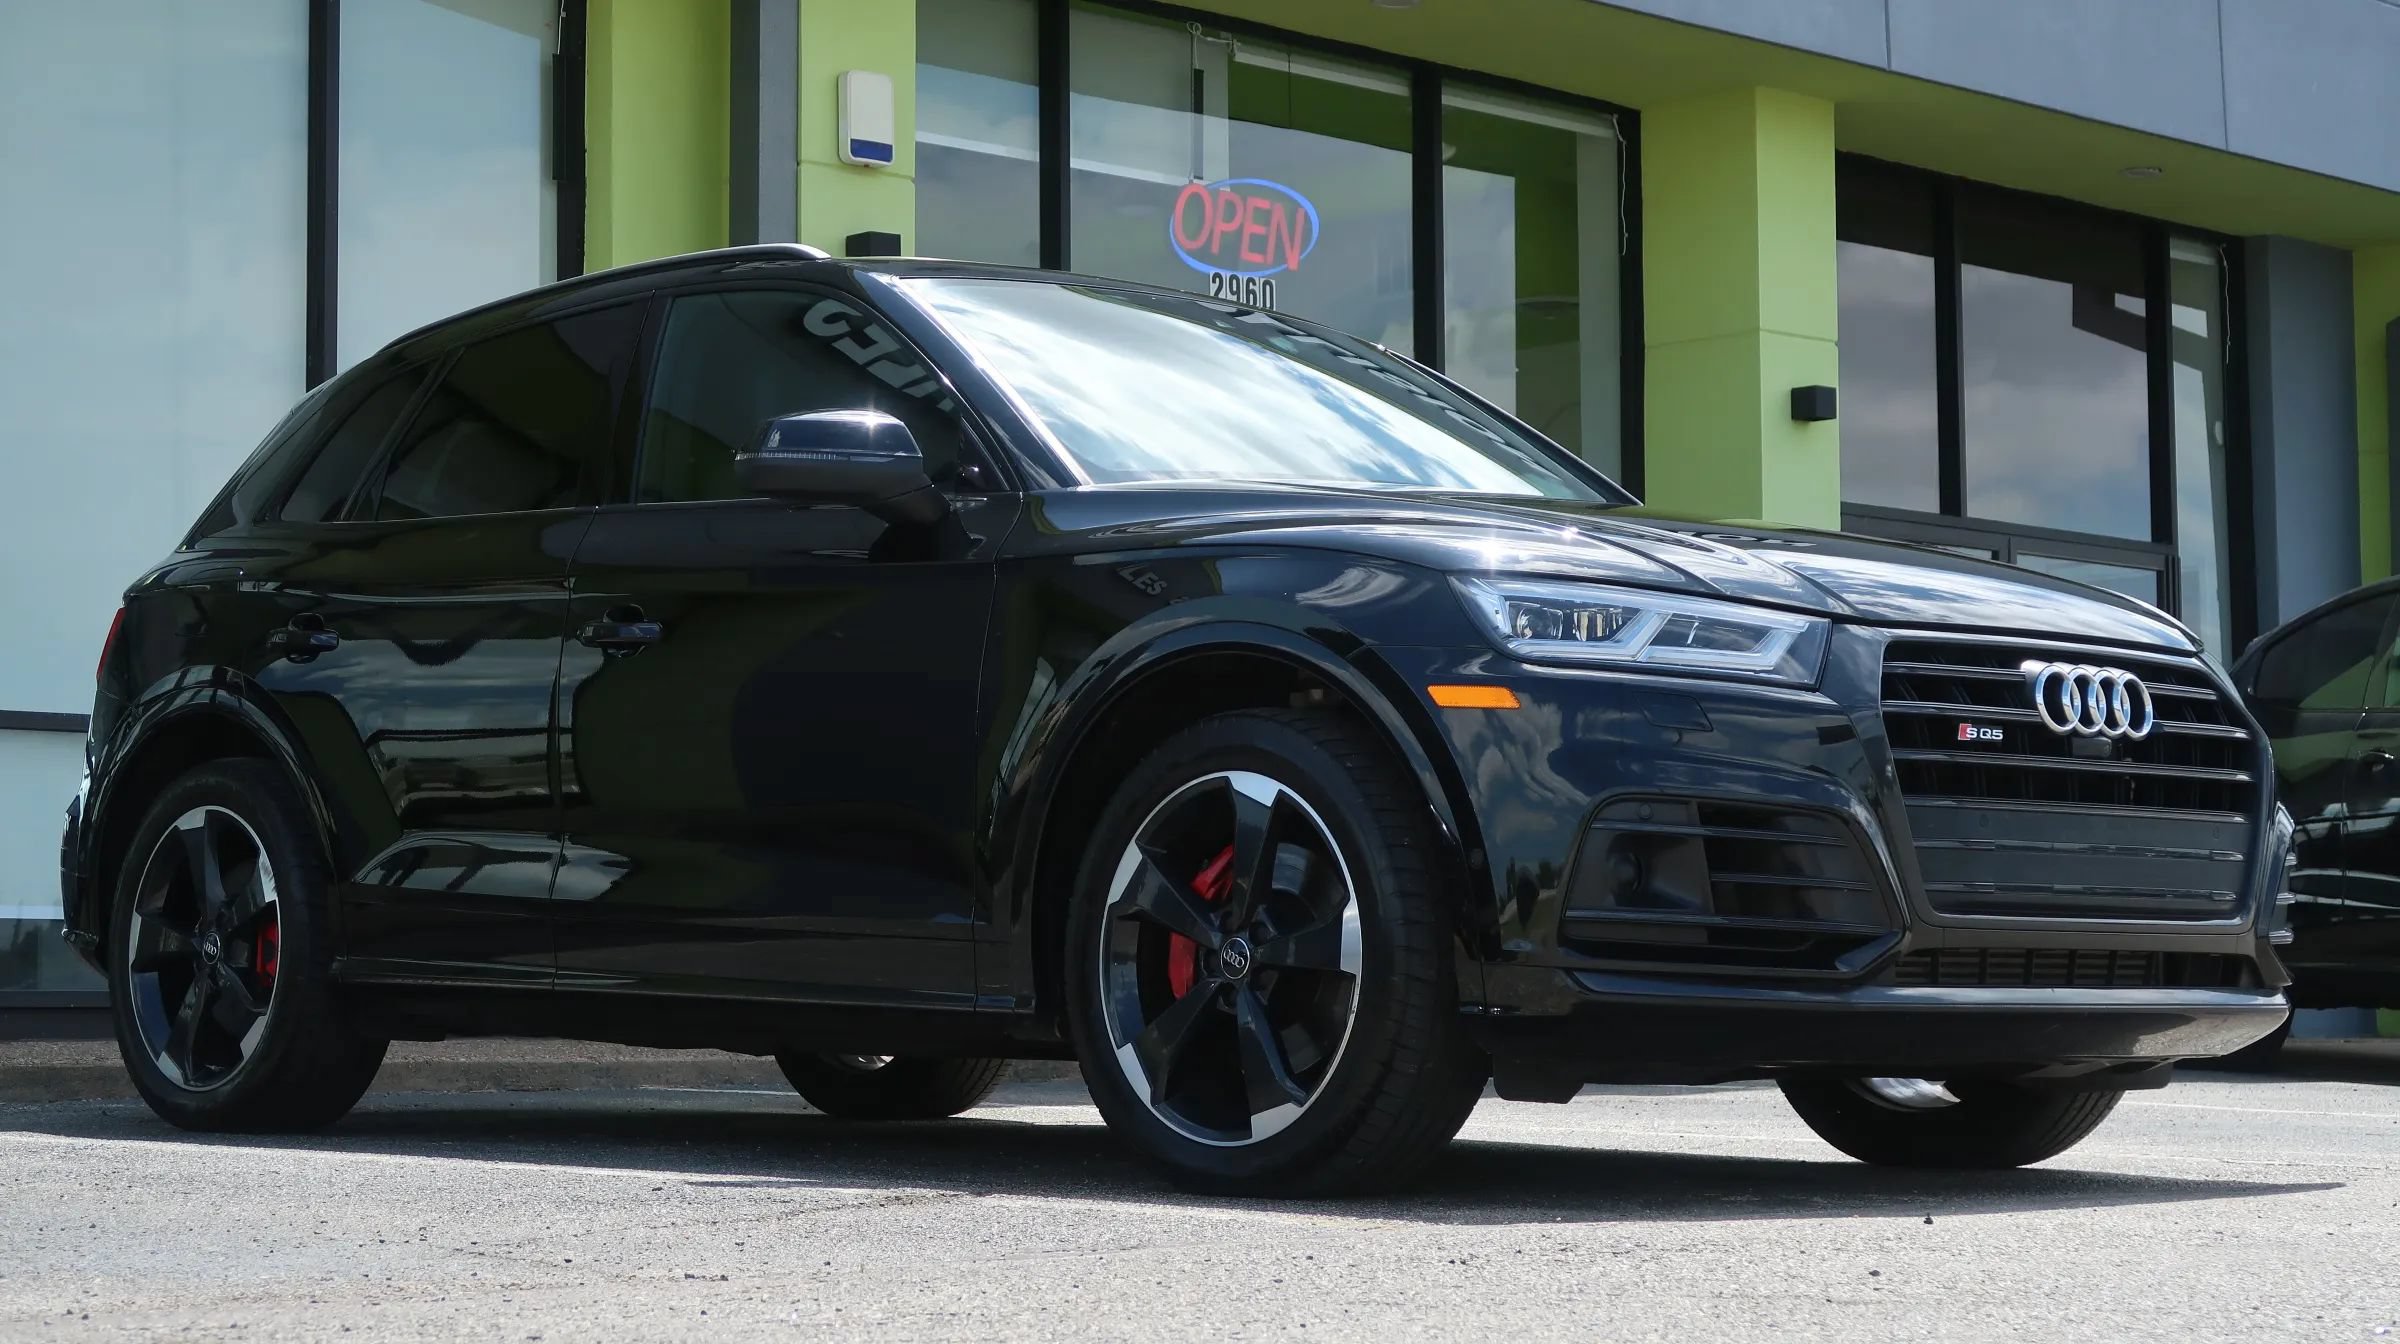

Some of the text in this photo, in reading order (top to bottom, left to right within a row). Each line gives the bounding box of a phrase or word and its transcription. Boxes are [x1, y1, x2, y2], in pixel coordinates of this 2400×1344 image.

[1173, 183, 1306, 271] OPEN
[1211, 272, 1274, 310] 2960
[1965, 727, 2004, 740] SQ5
